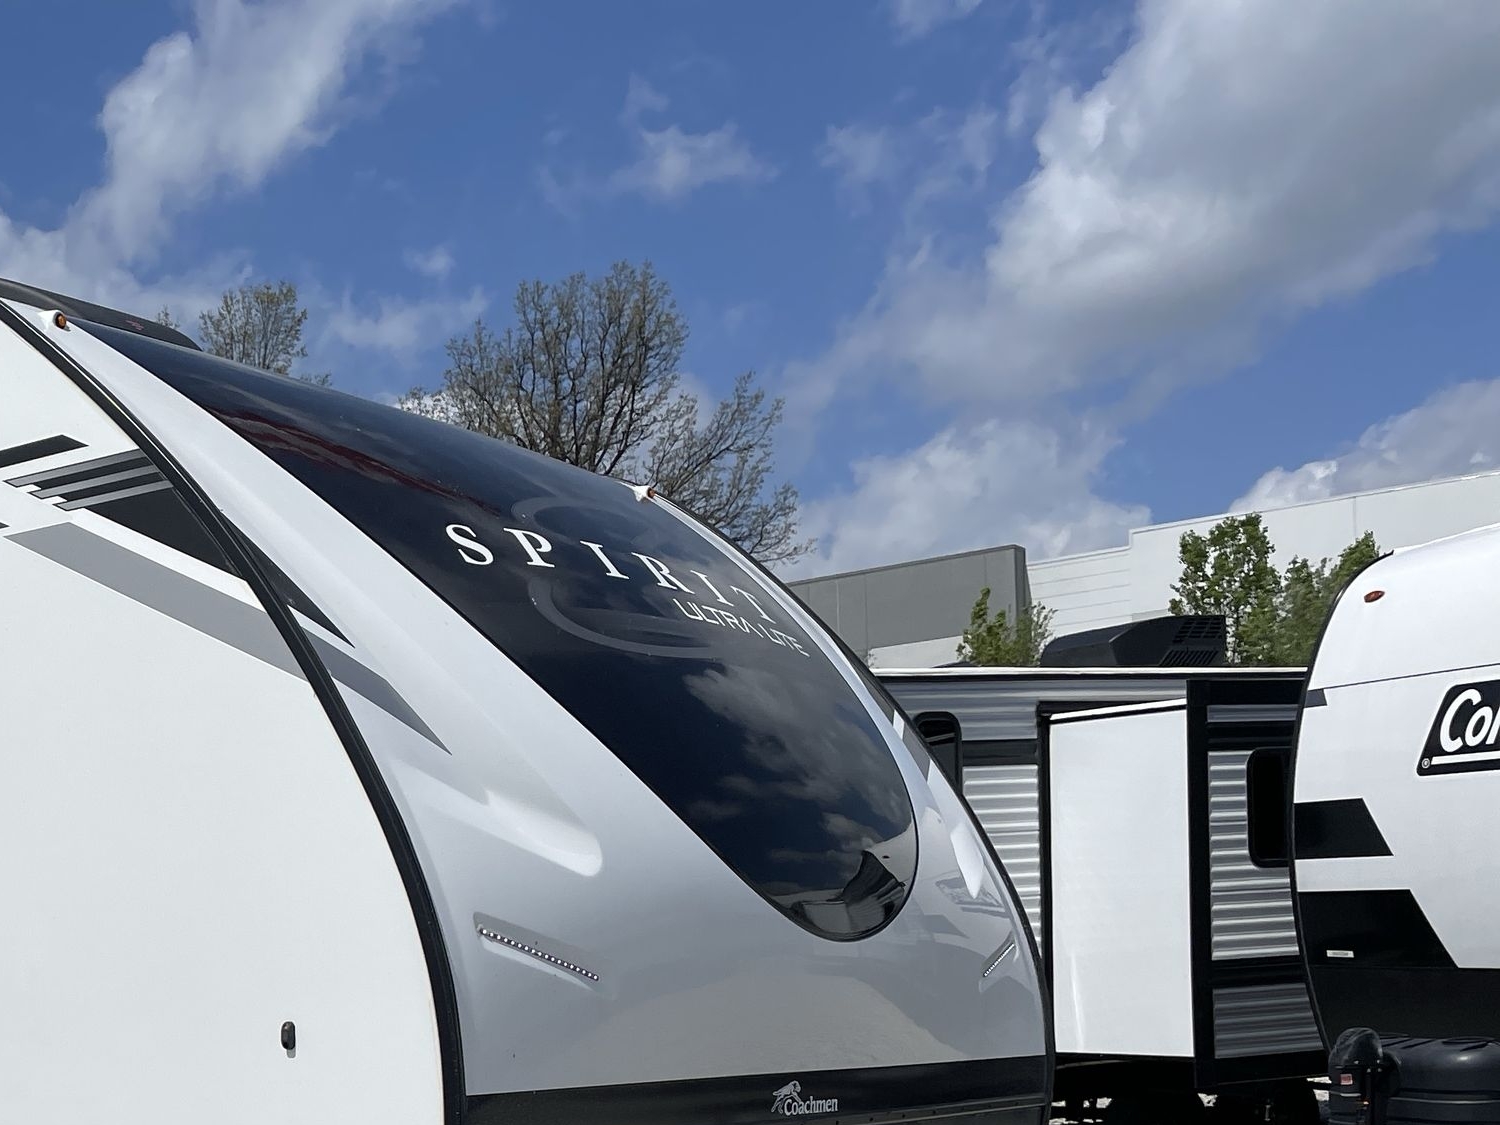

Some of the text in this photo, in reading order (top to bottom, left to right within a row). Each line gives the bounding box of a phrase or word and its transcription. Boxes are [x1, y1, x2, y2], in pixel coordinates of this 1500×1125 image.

[445, 523, 776, 624] SPIRIT
[673, 598, 810, 658] ULTRA LITE
[784, 1095, 838, 1116] Coachmen
